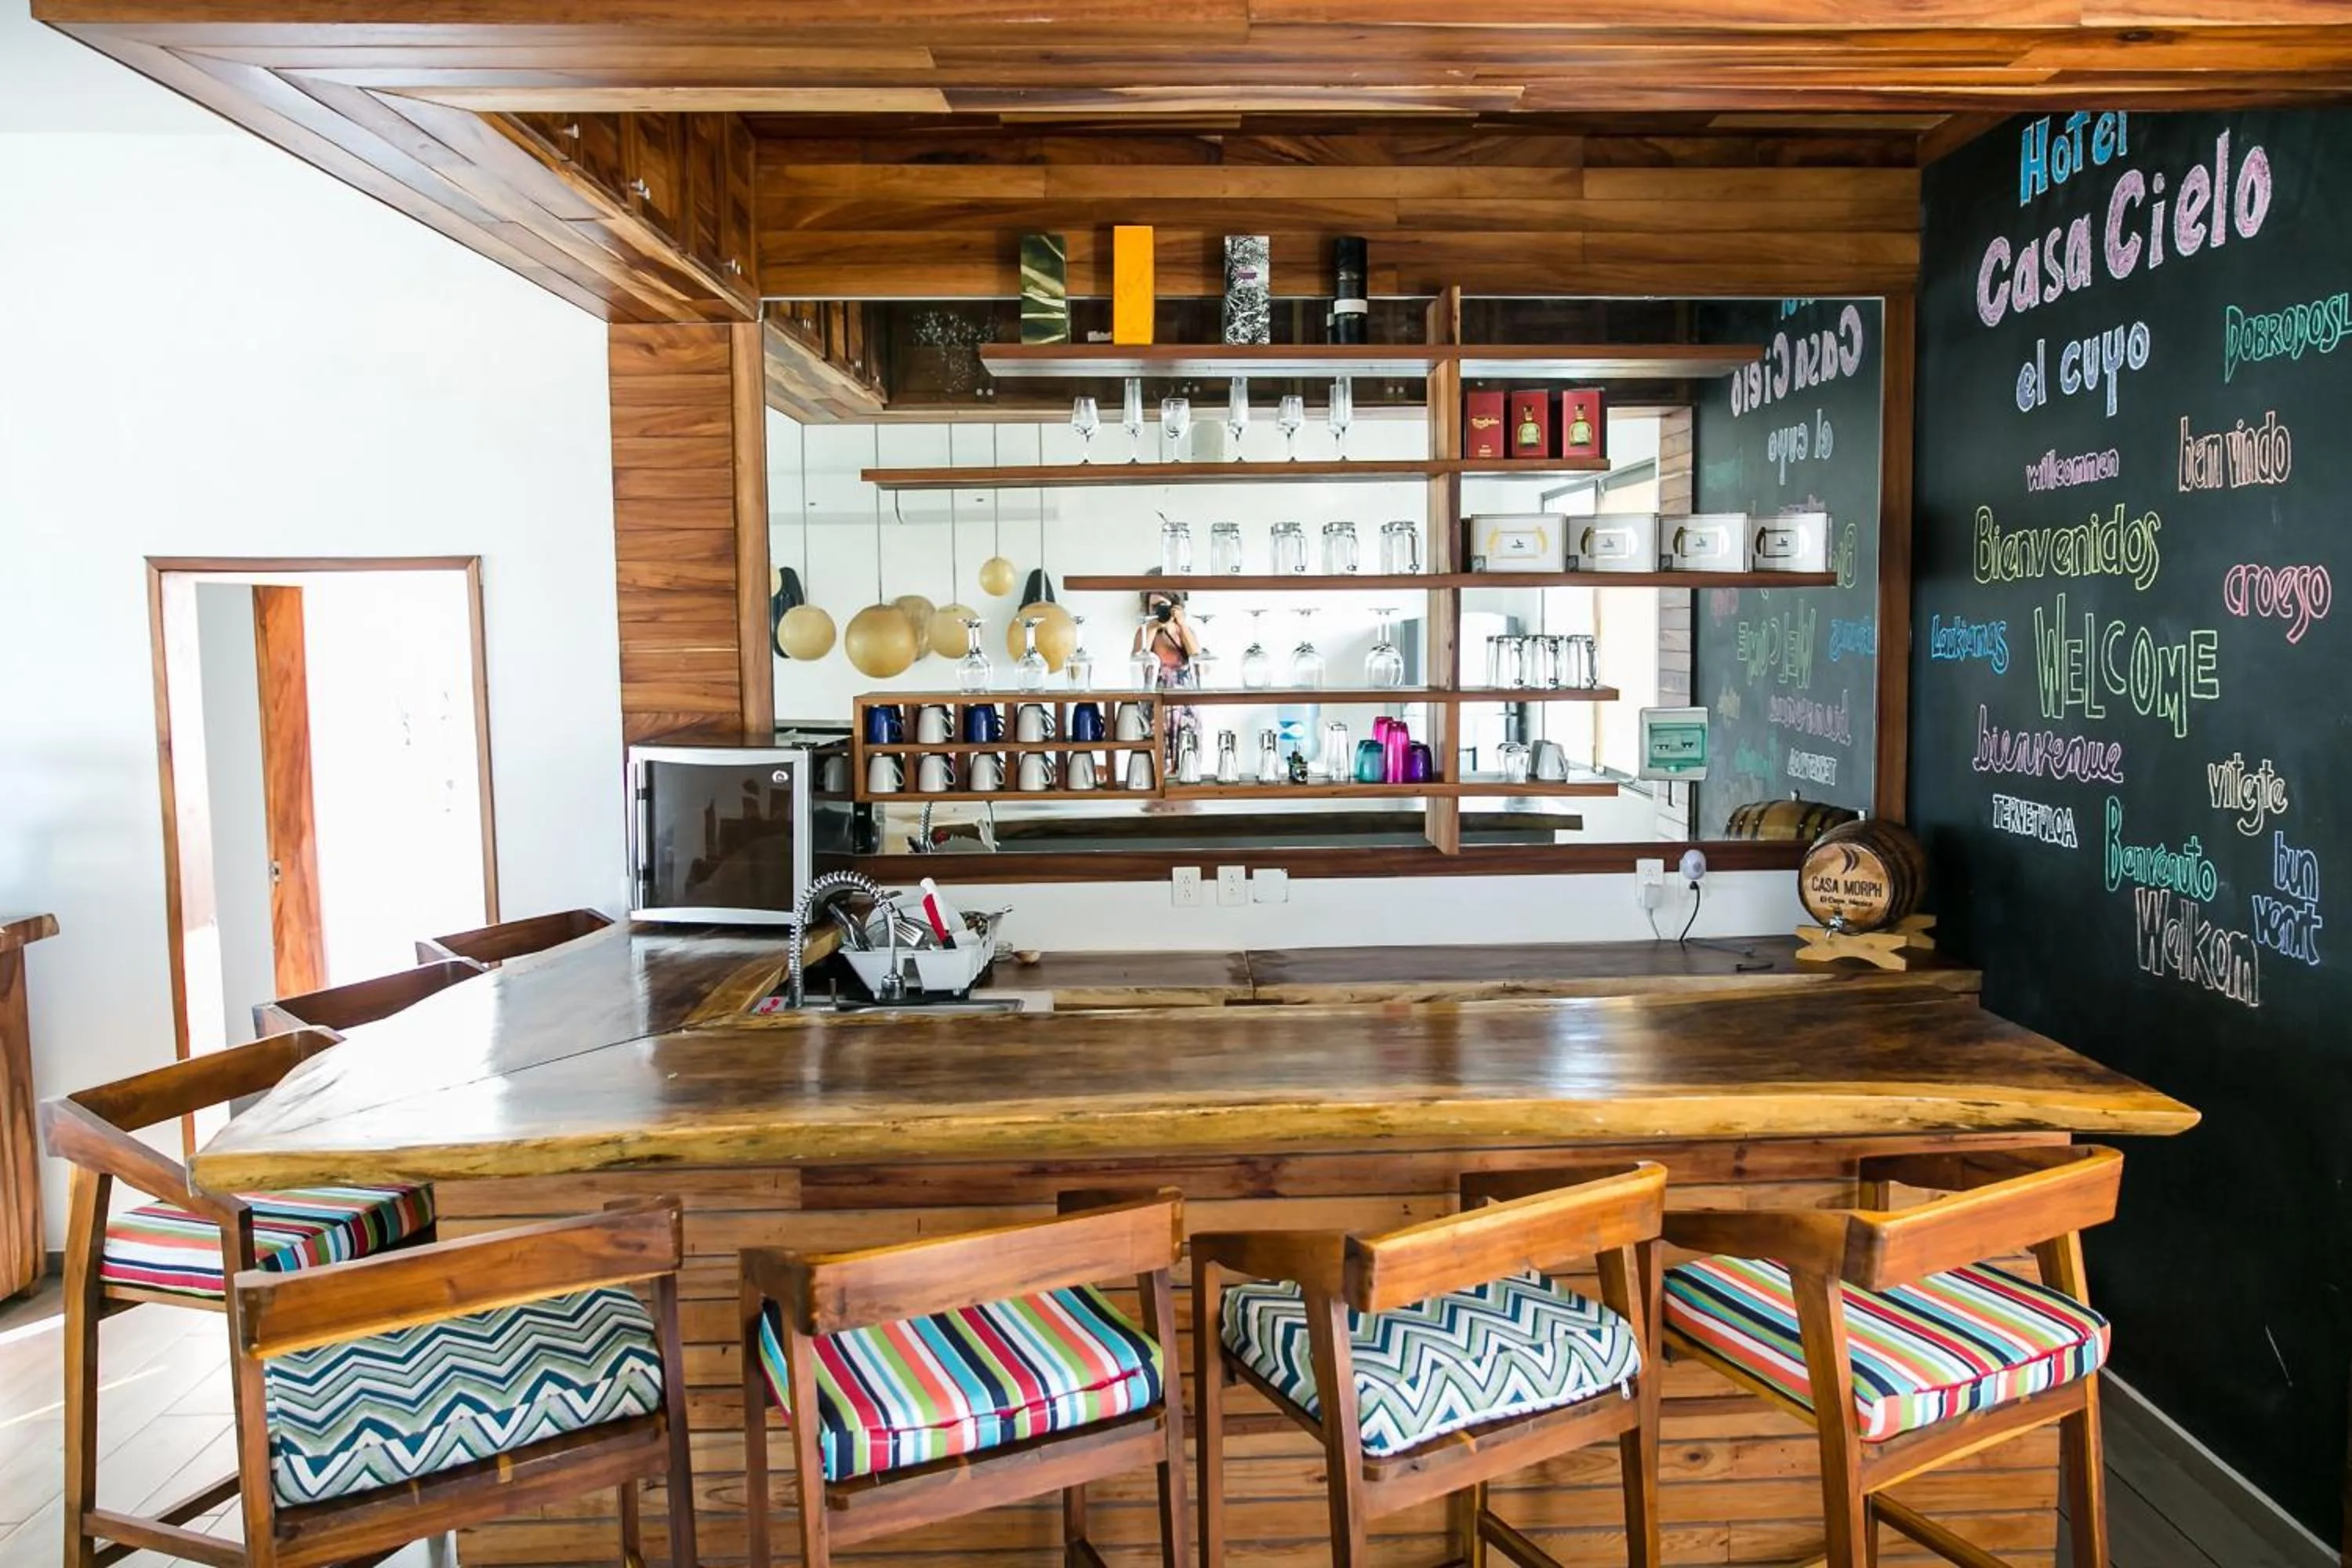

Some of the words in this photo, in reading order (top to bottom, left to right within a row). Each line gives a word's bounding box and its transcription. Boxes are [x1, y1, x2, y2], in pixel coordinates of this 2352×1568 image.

[1976, 212, 2092, 327] Casa
[2103, 126, 2273, 279] Cielo
[2016, 339, 2047, 412] el
[2060, 321, 2151, 418] cuyo
[2226, 410, 2292, 488] vindo
[1973, 503, 2161, 590] Bienvenidos
[2224, 563, 2332, 644] croeso
[2034, 592, 2220, 738] WELCOME
[1973, 703, 2124, 783] bienvenue
[1811, 875, 1839, 894] CASA
[1843, 879, 1882, 898] MORPH
[2106, 795, 2217, 902] Benvenuto
[2274, 830, 2319, 902] bun
[2135, 887, 2259, 1007] Welkom
